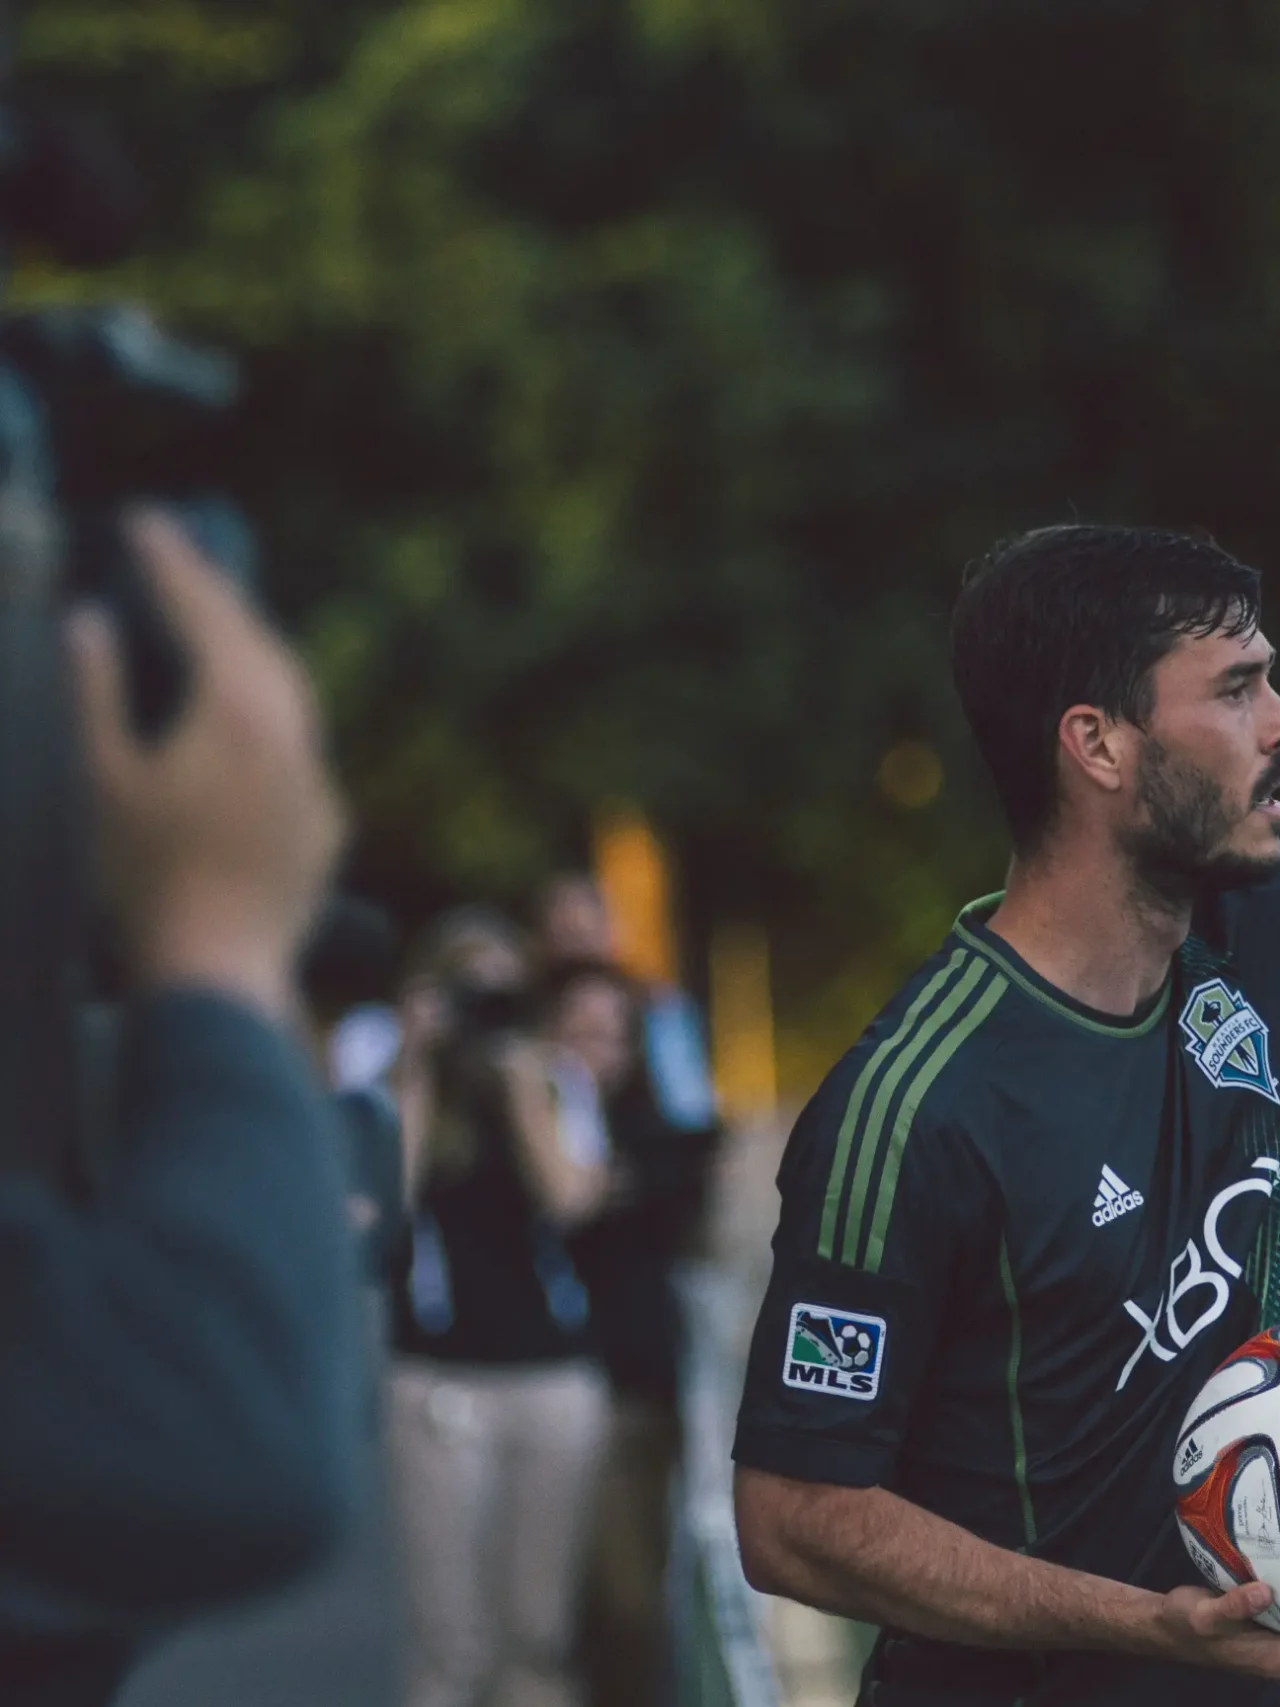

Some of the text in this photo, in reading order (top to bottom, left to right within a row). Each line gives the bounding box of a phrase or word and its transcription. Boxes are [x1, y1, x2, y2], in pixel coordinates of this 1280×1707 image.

[1208, 1017, 1258, 1072] SOUNDERS FC
[1091, 1189, 1145, 1227] adidas
[788, 1362, 873, 1393] MLS
[1180, 1450, 1203, 1477] adidas
